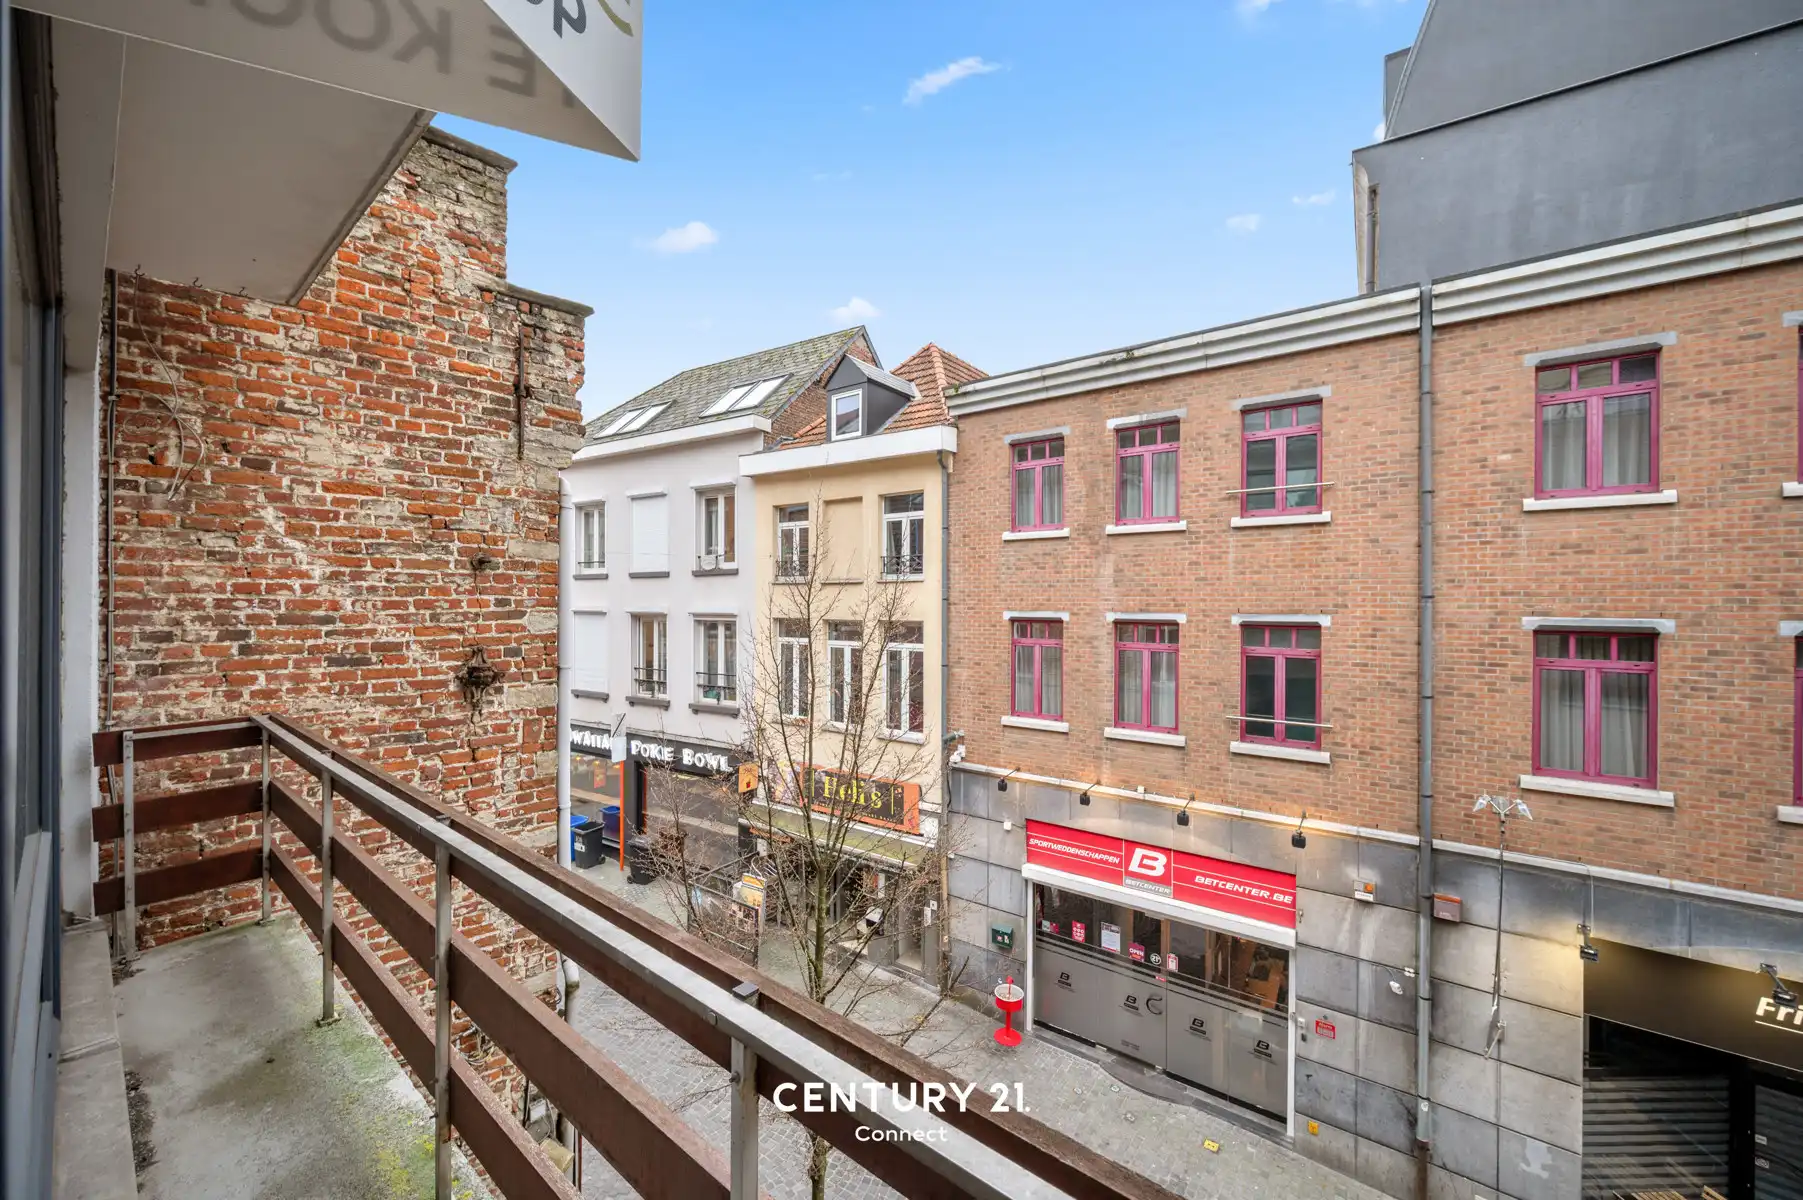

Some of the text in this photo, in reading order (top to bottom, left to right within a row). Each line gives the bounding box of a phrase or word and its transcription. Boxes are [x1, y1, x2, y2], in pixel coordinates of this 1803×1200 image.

[569, 728, 733, 773] WAIIA POKE BOWL
[1029, 838, 1120, 864] SPORTWEDDENSCHAPPEN
[1128, 847, 1167, 877] B
[1125, 879, 1171, 894] BETCENTER
[1194, 875, 1293, 904] BETCENTER.BE
[1129, 947, 1144, 957] OPEN
